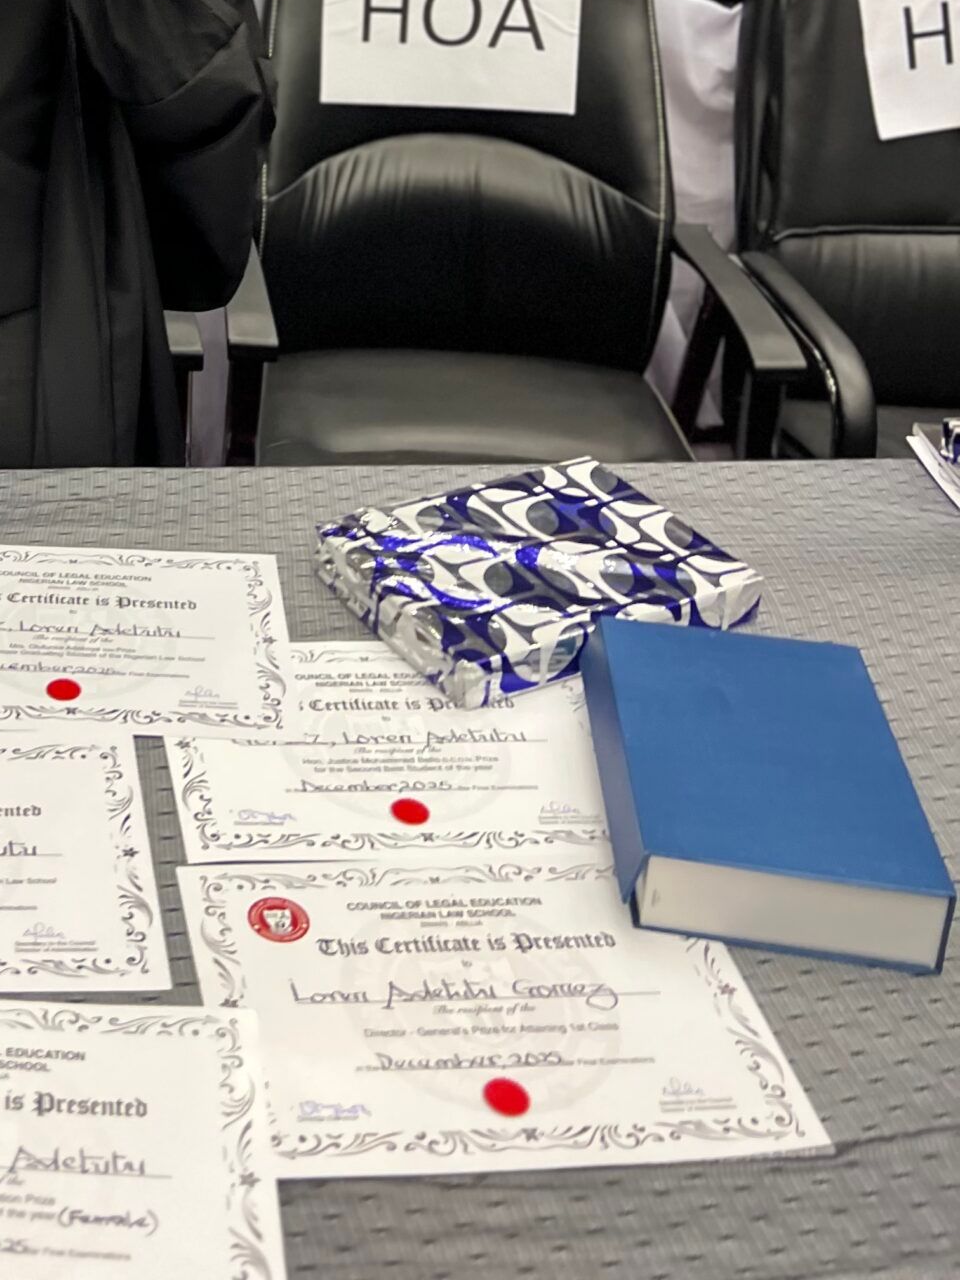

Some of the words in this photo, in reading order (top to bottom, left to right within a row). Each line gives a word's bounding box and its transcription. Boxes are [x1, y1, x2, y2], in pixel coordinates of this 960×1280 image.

[94, 574, 152, 582] EDUCATION
[7, 592, 89, 606] Certificate
[96, 595, 109, 606] is
[116, 596, 197, 610] Presented
[309, 699, 399, 711] Certificate
[405, 698, 421, 710] is
[341, 731, 412, 744] Loren
[346, 901, 402, 910] COUNCIL
[405, 900, 423, 909] OF
[426, 899, 467, 908] LEGAL
[470, 897, 542, 907] EDUCATION
[467, 909, 516, 917] SCHOOL
[316, 937, 369, 957] This
[374, 936, 481, 955] Certificate
[486, 933, 507, 951] is
[514, 931, 616, 954] Presented
[5, 1047, 86, 1061] EDUCATION
[4, 1090, 26, 1111] is
[32, 1090, 148, 1118] Presented
